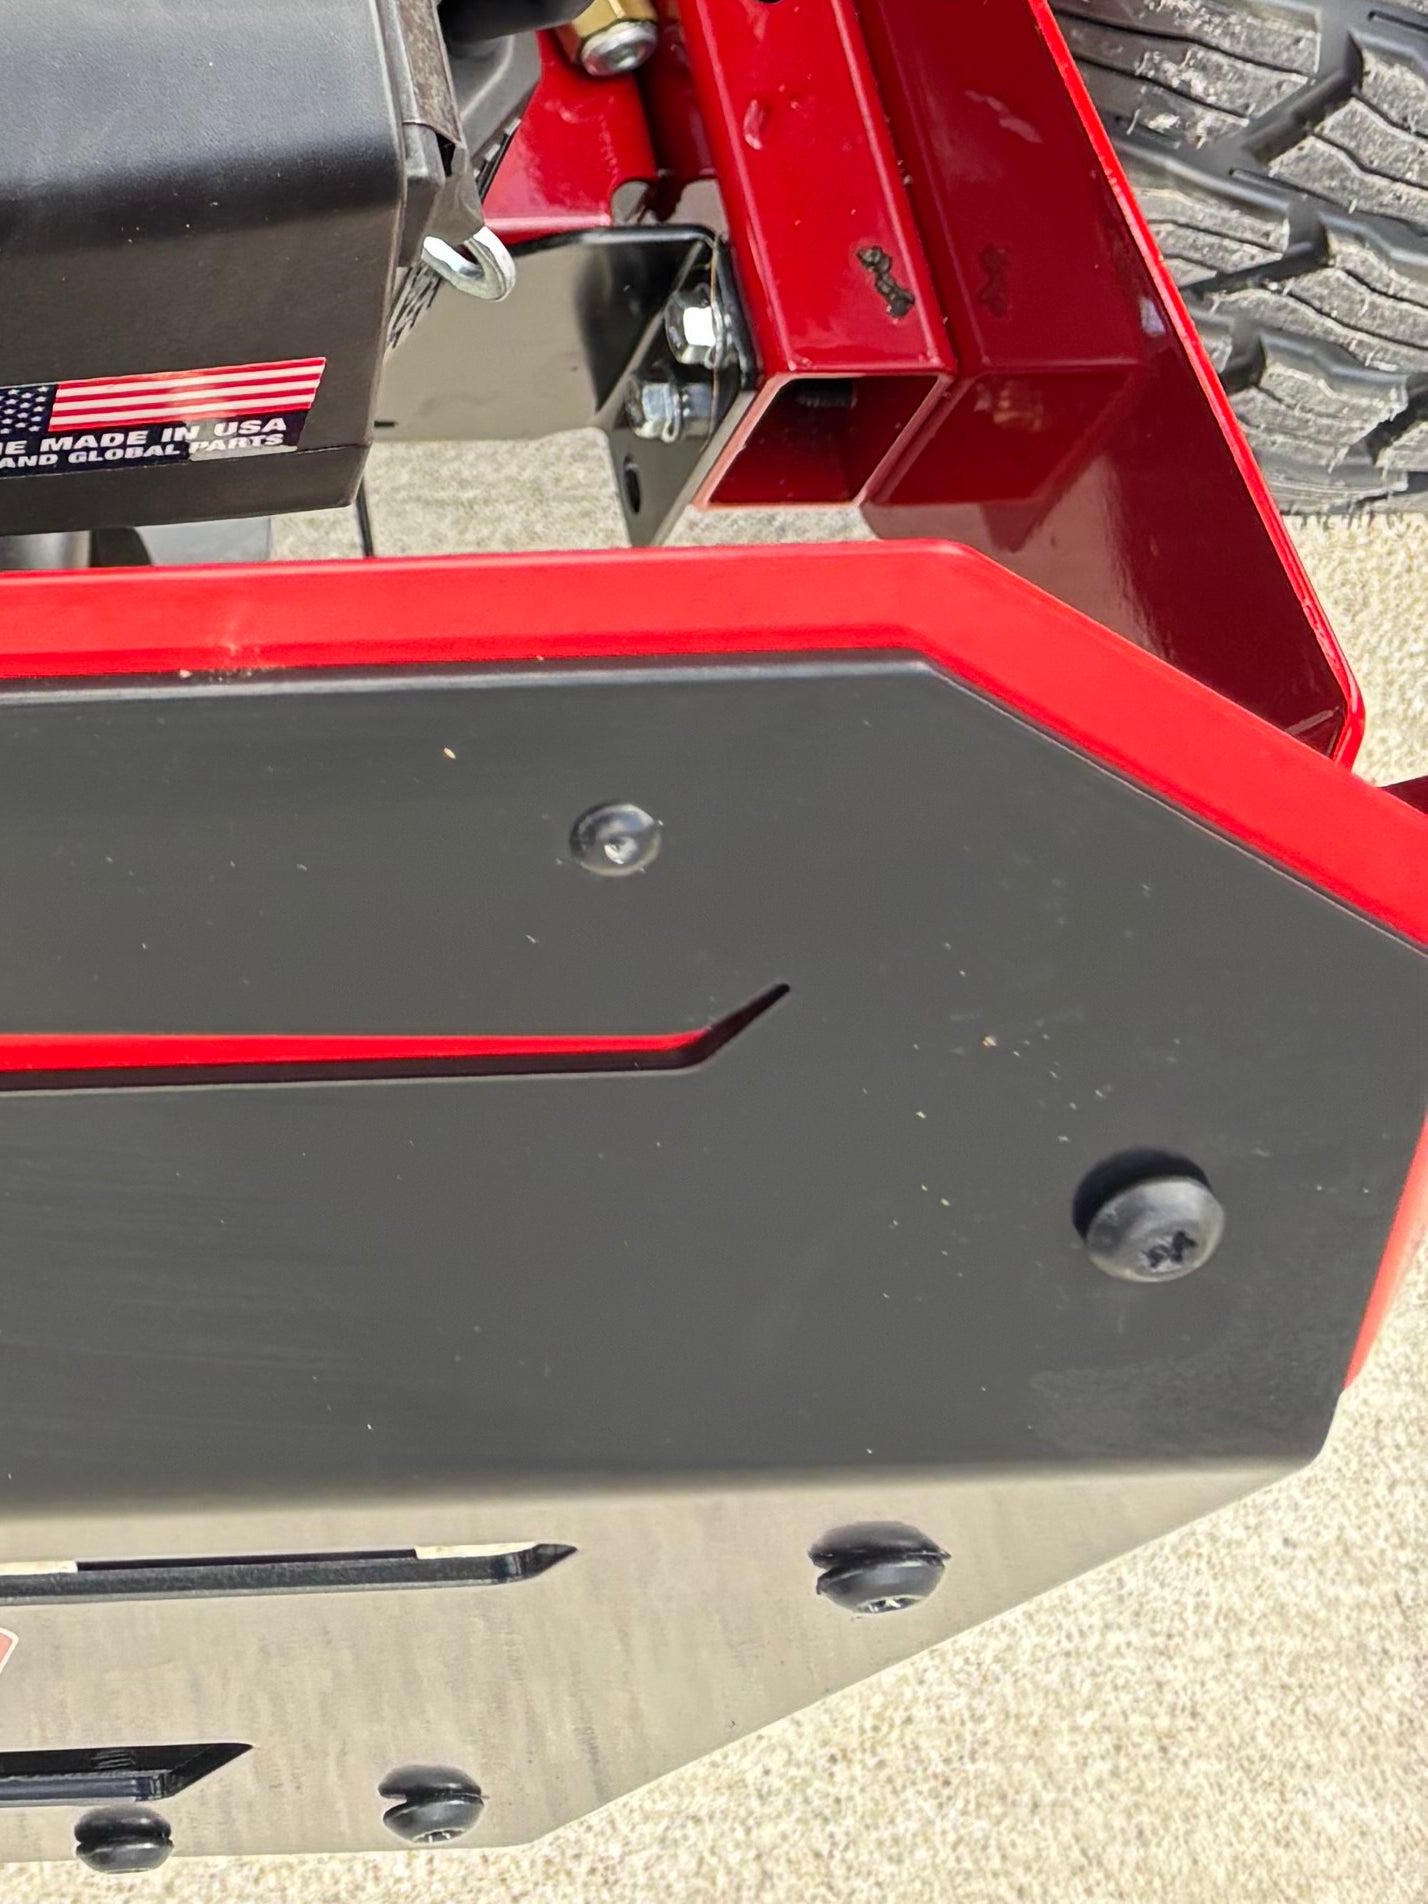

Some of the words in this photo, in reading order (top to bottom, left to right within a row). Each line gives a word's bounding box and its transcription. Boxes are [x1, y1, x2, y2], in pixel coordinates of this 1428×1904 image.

[39, 430, 147, 453] MADE
[160, 424, 199, 443] IN
[213, 418, 288, 437] USA
[67, 443, 181, 465] GLOBAL
[190, 433, 285, 454] PARTS
